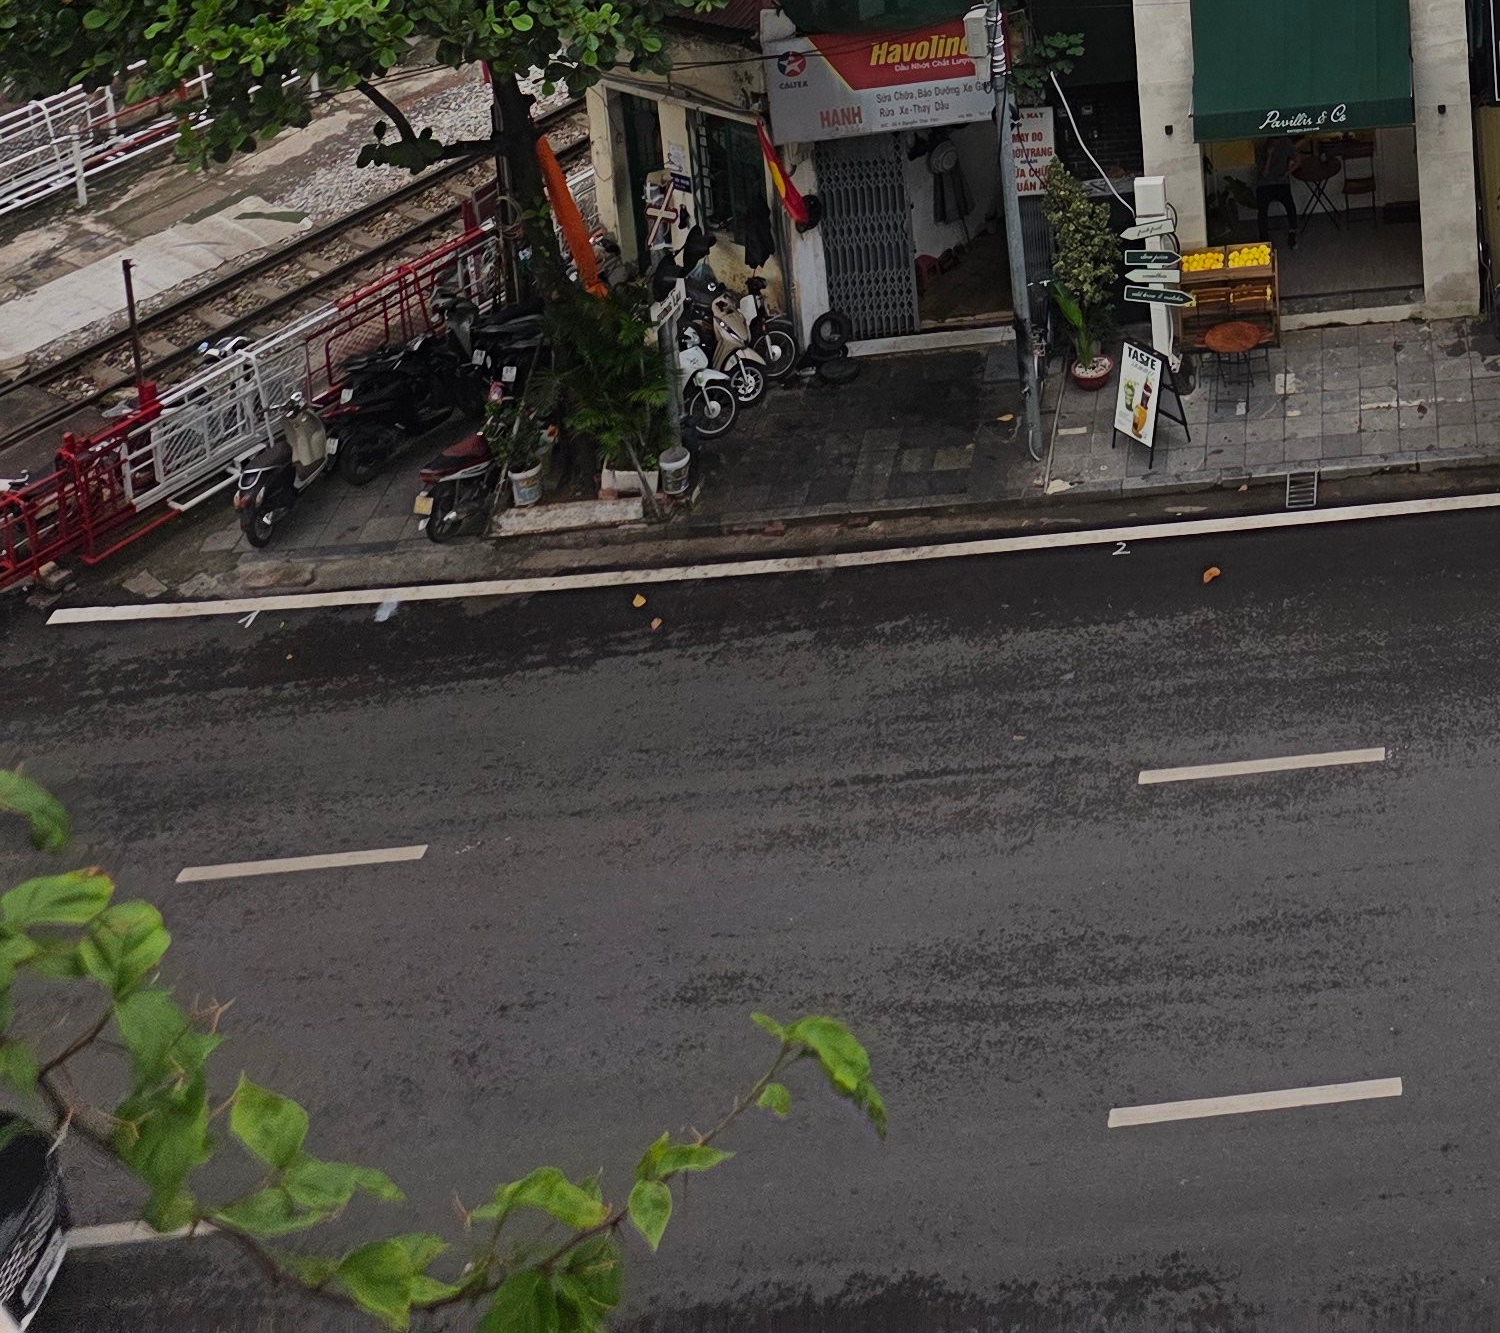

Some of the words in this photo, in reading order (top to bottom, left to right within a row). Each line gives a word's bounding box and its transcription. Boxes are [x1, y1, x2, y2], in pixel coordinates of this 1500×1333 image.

[779, 81, 809, 90] CALTEX
[963, 83, 973, 93] Xe
[1259, 110, 1313, 130] Pavillis
[1316, 111, 1328, 125] &
[1128, 346, 1157, 371] TASTE
[1112, 542, 1131, 555] 2
